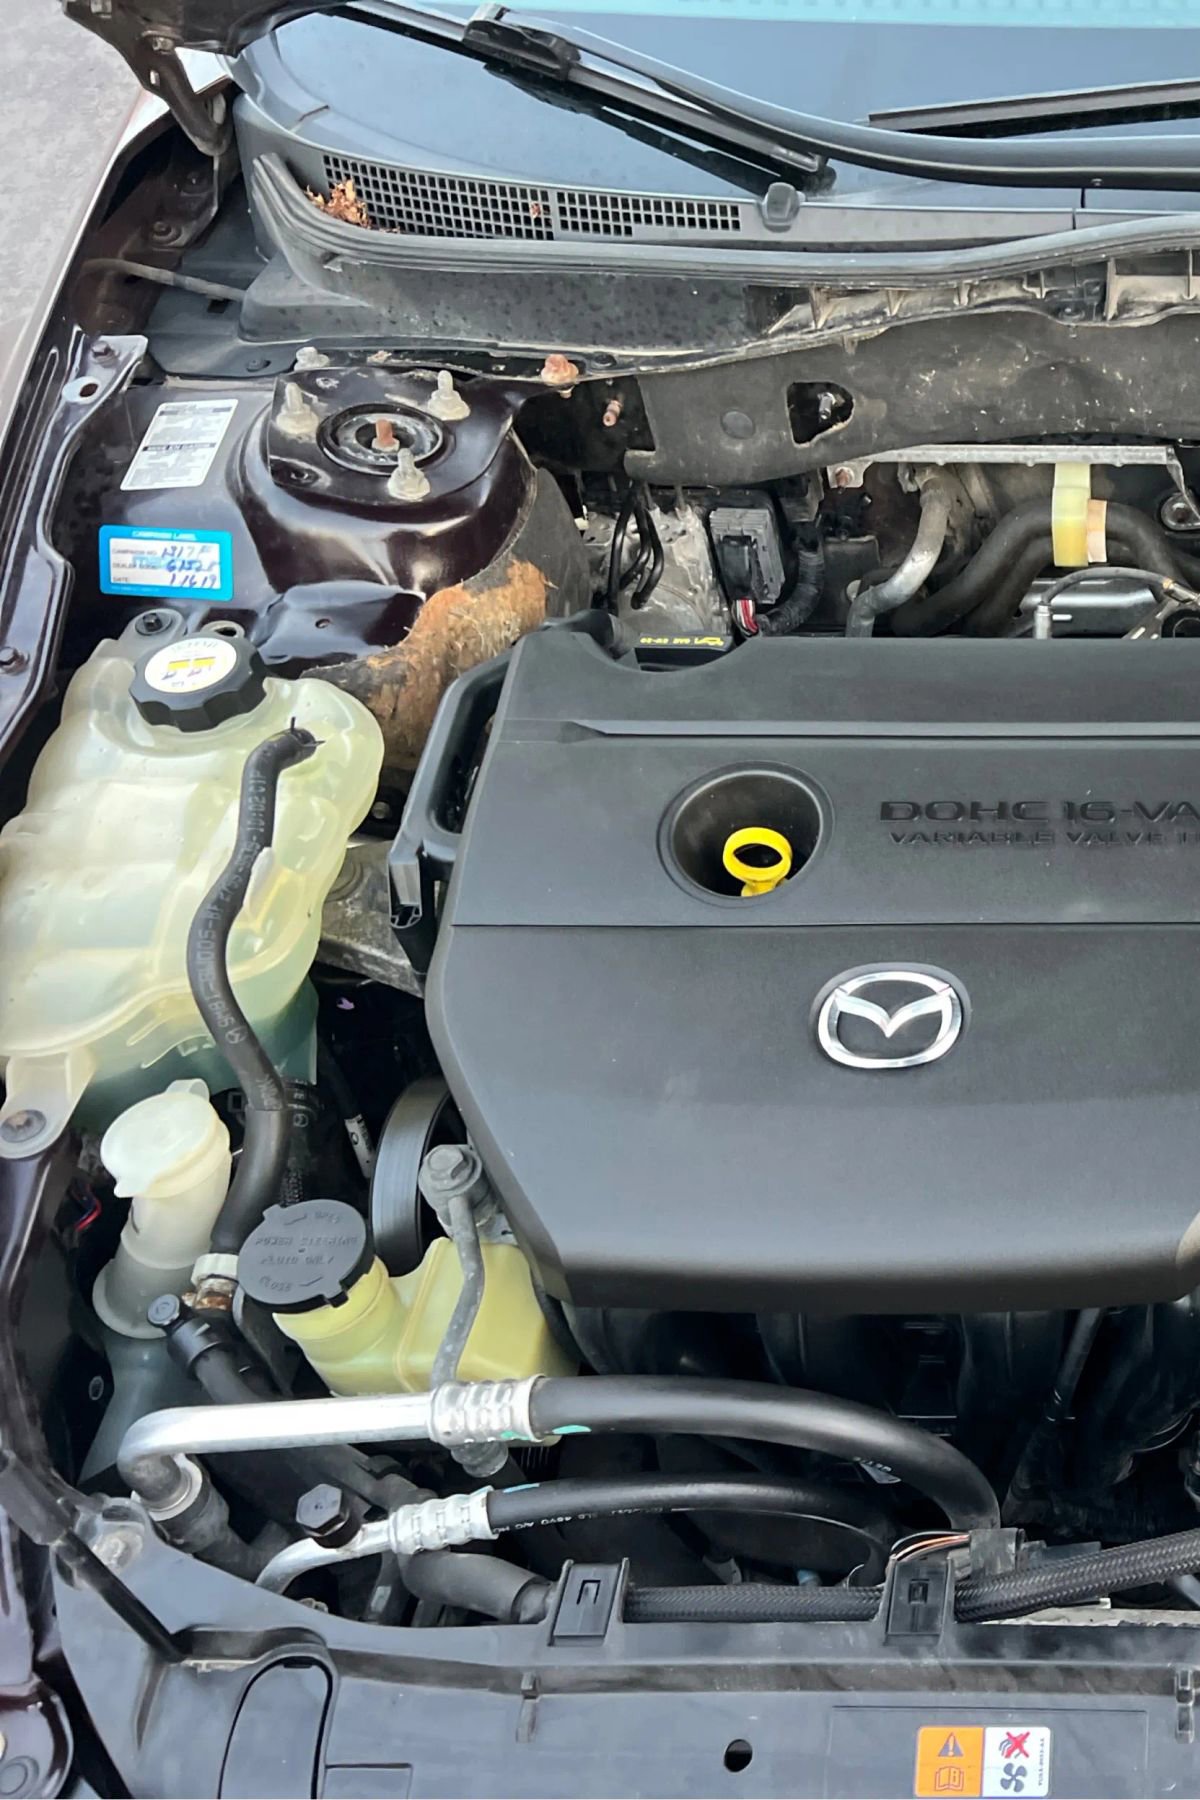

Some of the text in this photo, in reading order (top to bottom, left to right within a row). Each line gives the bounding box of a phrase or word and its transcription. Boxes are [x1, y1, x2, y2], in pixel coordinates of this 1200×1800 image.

[879, 800, 1049, 823] DOHC
[888, 831, 1056, 847] VARIABLE
[1065, 831, 1164, 847] VALVE
